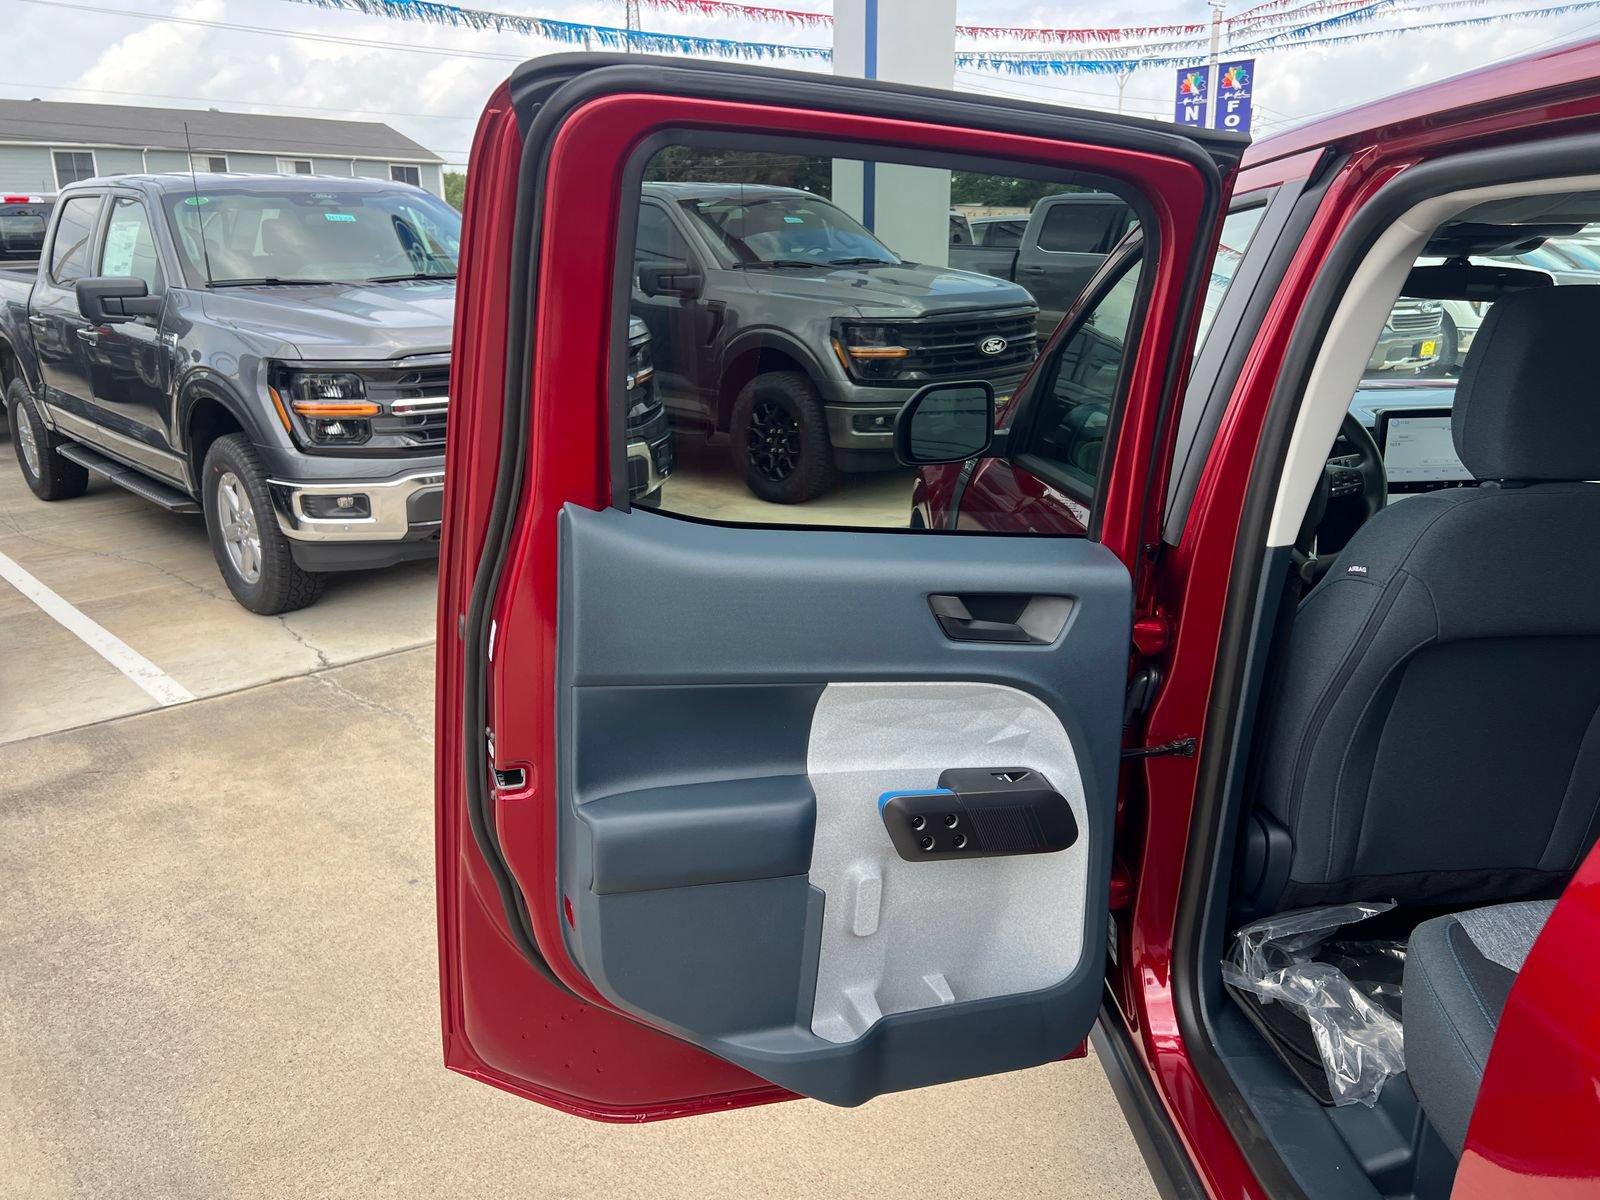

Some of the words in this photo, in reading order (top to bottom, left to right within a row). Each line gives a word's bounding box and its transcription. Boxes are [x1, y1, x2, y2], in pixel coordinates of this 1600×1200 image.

[1185, 105, 1199, 127] N
[1224, 100, 1240, 132] FO
[985, 339, 1003, 352] Ford
